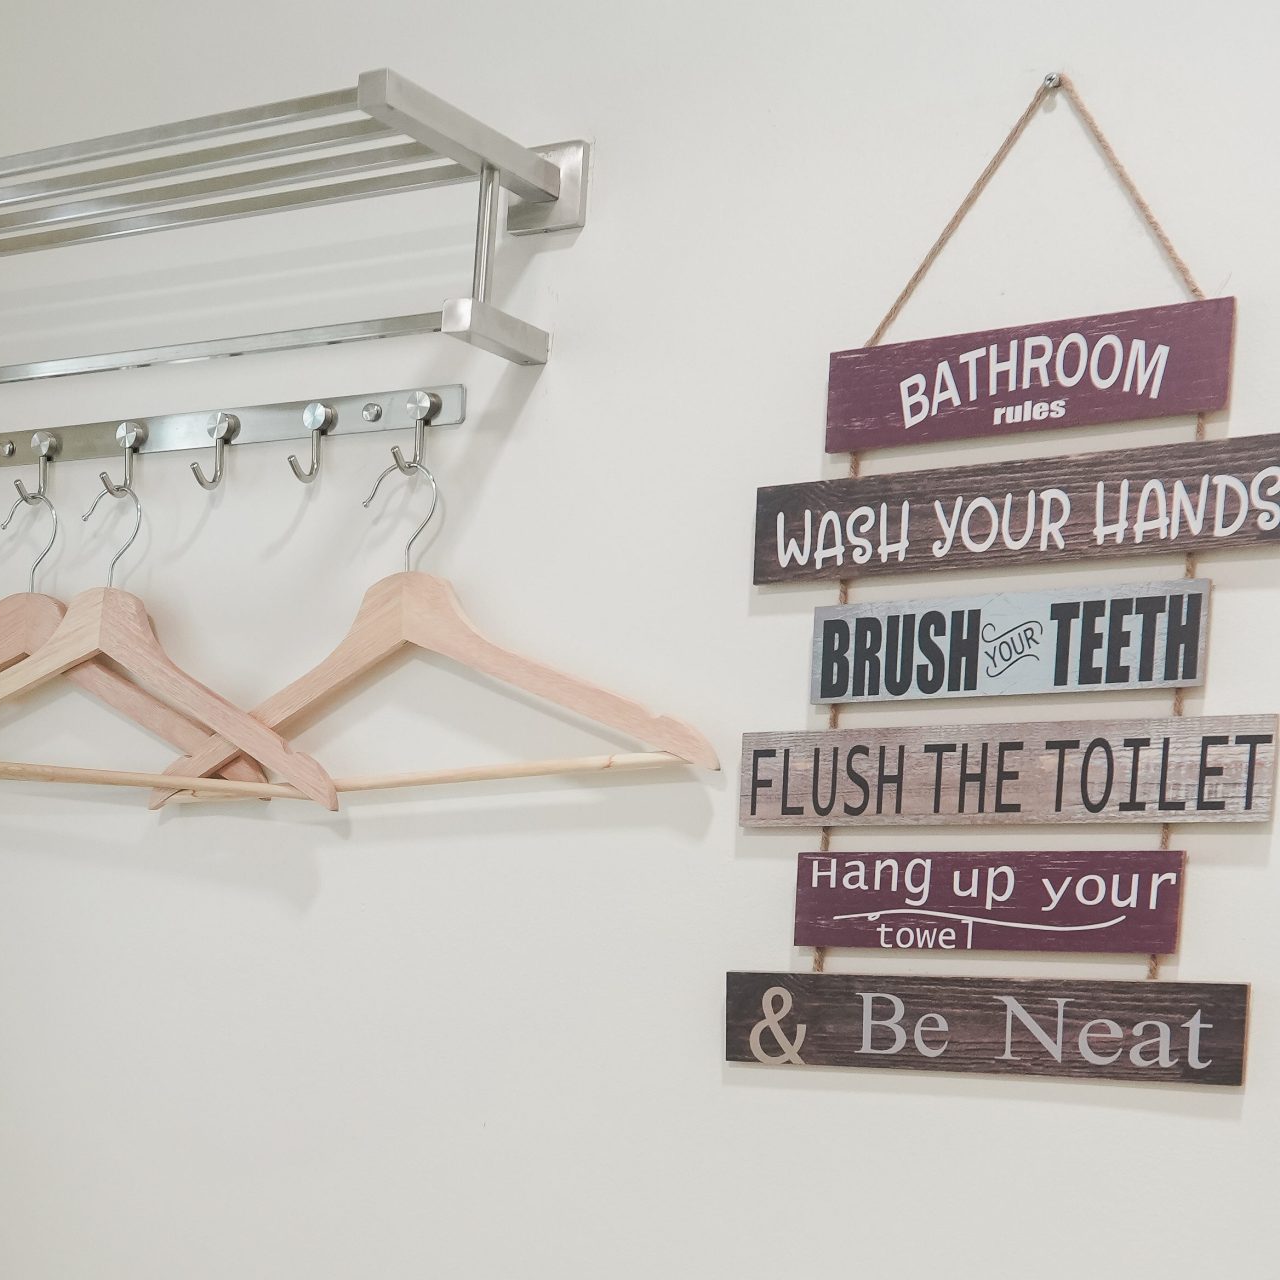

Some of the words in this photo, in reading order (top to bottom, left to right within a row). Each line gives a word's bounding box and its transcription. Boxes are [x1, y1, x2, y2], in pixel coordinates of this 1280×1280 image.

[899, 332, 1170, 429] BATHROOM
[992, 398, 1066, 426] rules
[776, 499, 911, 569] WASH
[933, 488, 1071, 559] YOUR
[1093, 465, 1280, 545] HANDS
[820, 608, 982, 699] BRUSH
[984, 627, 1040, 669] YOUR
[1050, 593, 1203, 686] TEETH
[749, 744, 906, 817] FLUSH
[924, 741, 1024, 814] THE
[1045, 734, 1273, 813] TOILET
[811, 857, 932, 906] Hang
[952, 864, 1015, 909] up
[1041, 872, 1177, 911] your
[876, 919, 974, 949] towel
[749, 986, 807, 1064] &
[854, 992, 950, 1058] Be
[993, 995, 1213, 1070] Neat
